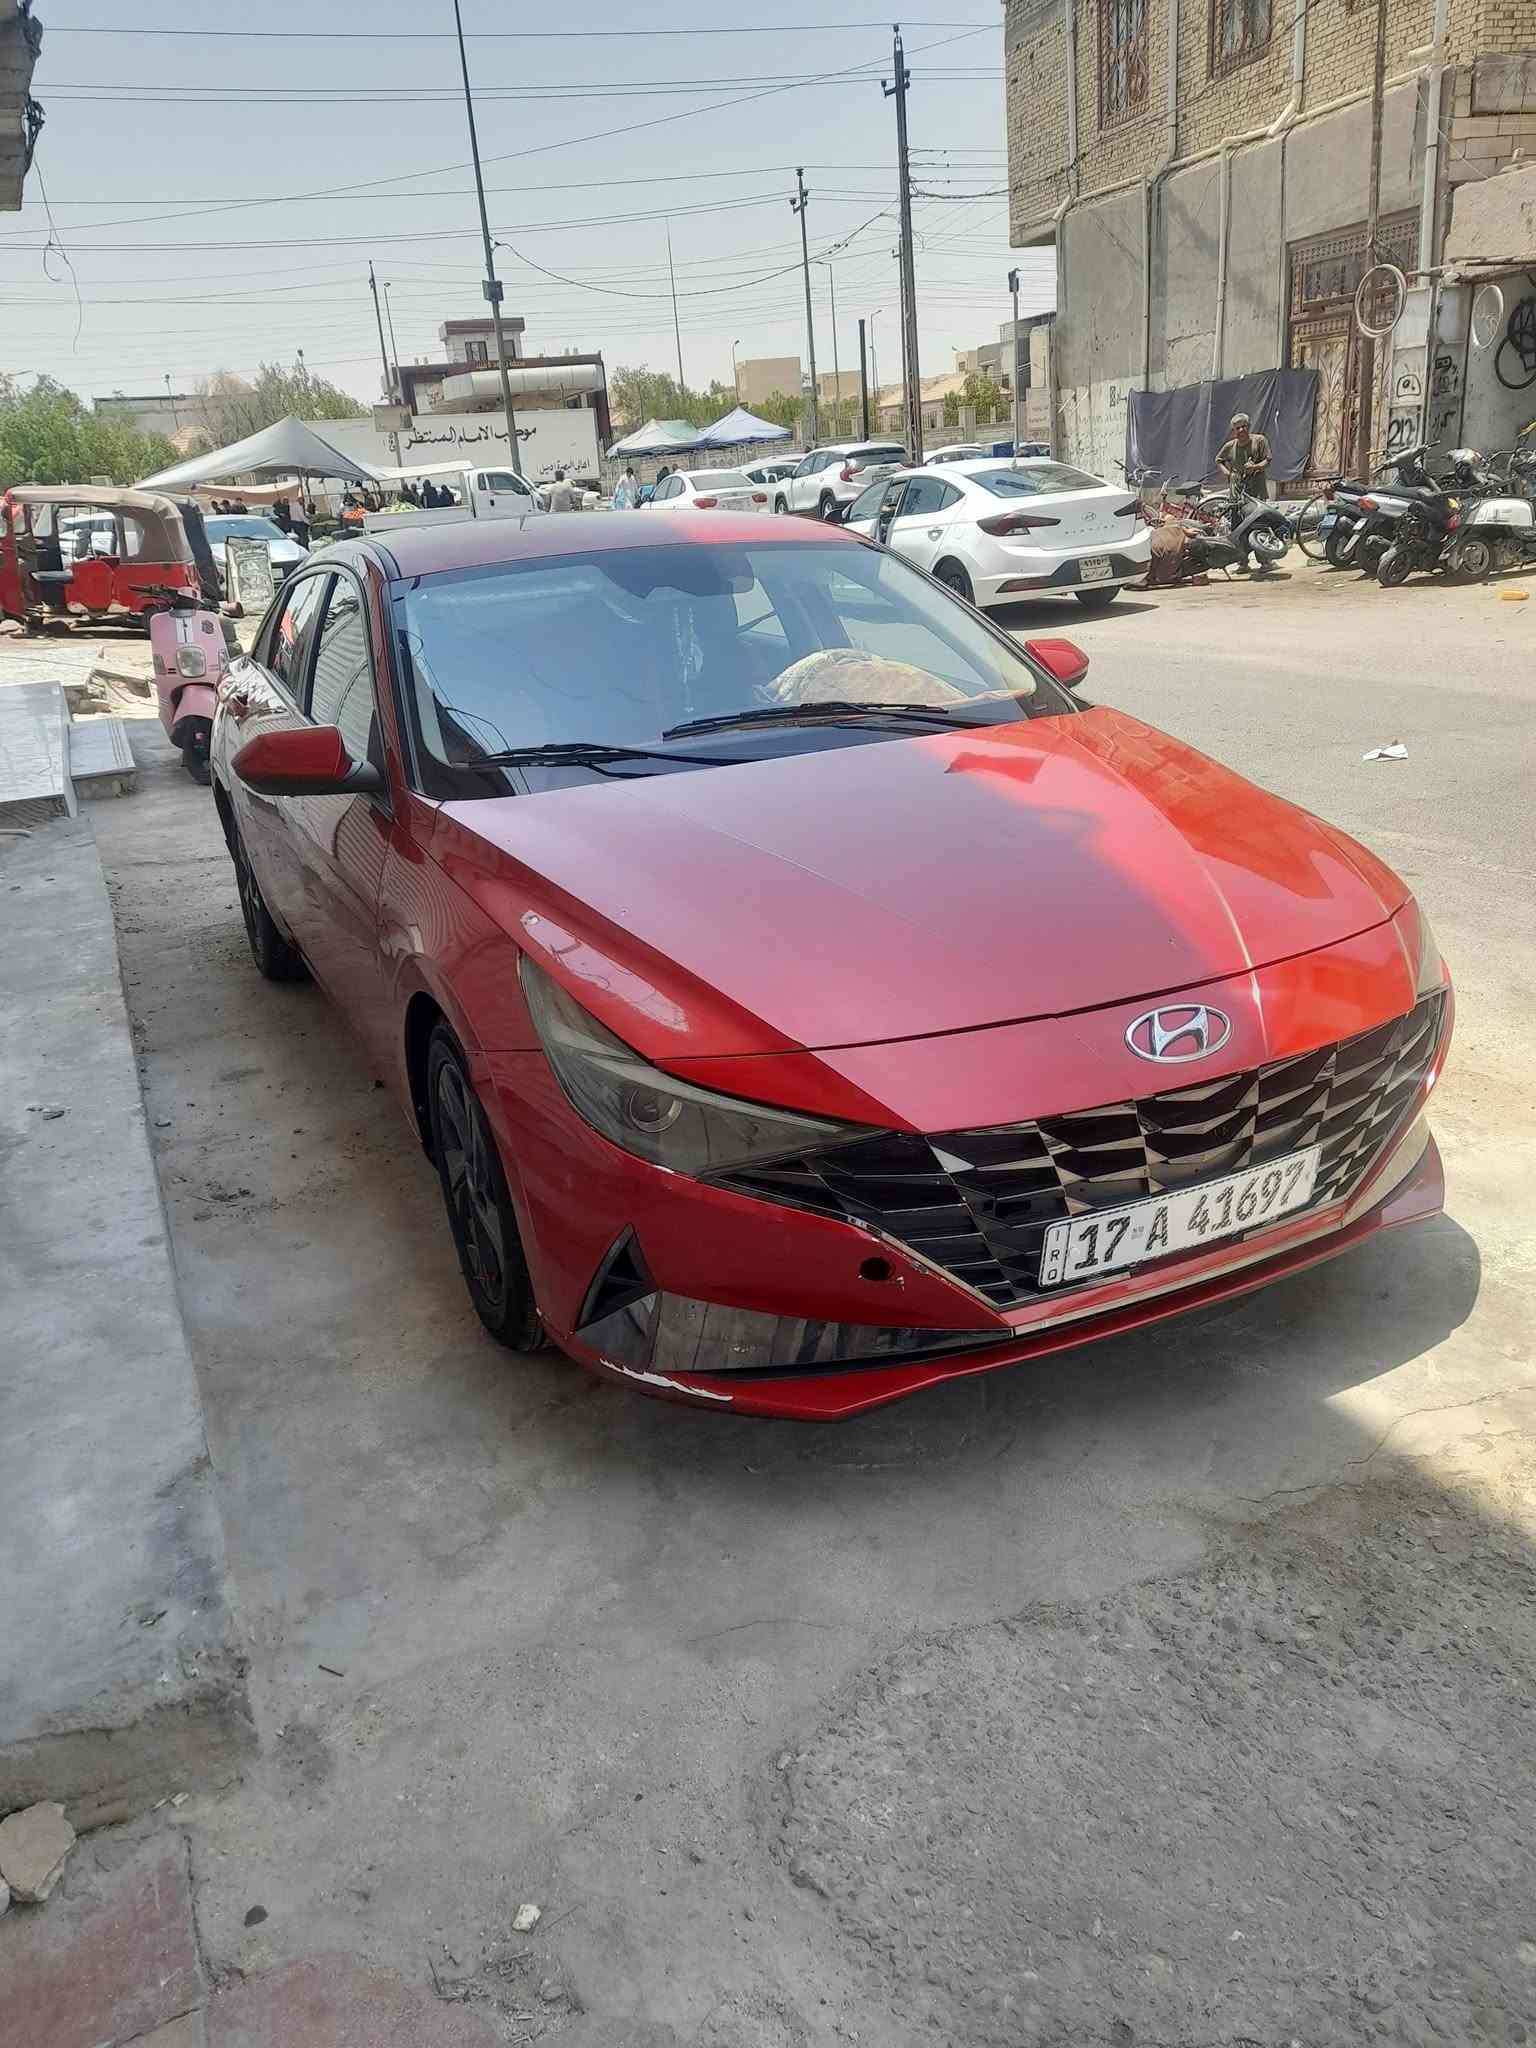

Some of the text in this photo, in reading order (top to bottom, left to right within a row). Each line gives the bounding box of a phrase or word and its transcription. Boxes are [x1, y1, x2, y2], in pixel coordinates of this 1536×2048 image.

[1075, 1159, 1305, 1271] 17 A 41697
